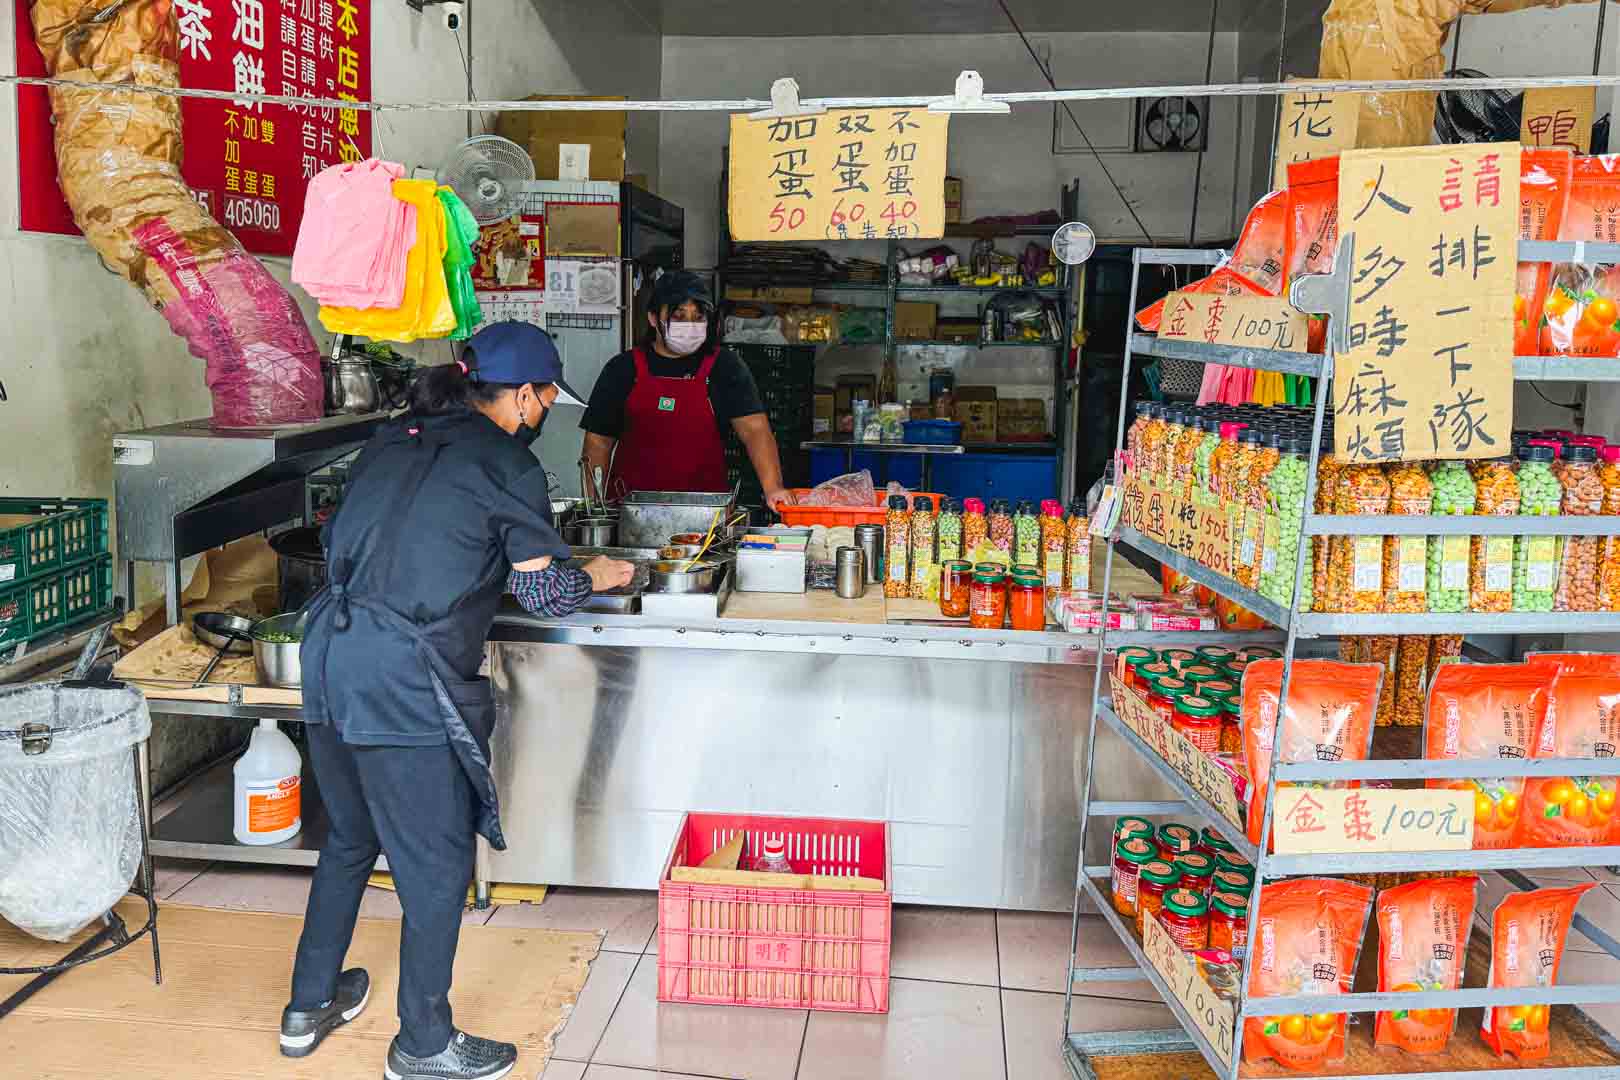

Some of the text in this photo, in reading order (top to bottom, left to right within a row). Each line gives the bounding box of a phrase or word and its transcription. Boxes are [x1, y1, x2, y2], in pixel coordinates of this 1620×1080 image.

[768, 116, 818, 200] 加蛋
[769, 201, 806, 233] 50
[829, 199, 865, 227] 60
[879, 199, 918, 225] 40
[1337, 164, 1413, 461] 人多時麻煩
[1428, 153, 1502, 453] 請排一下隊
[1381, 802, 1468, 836] 100元
